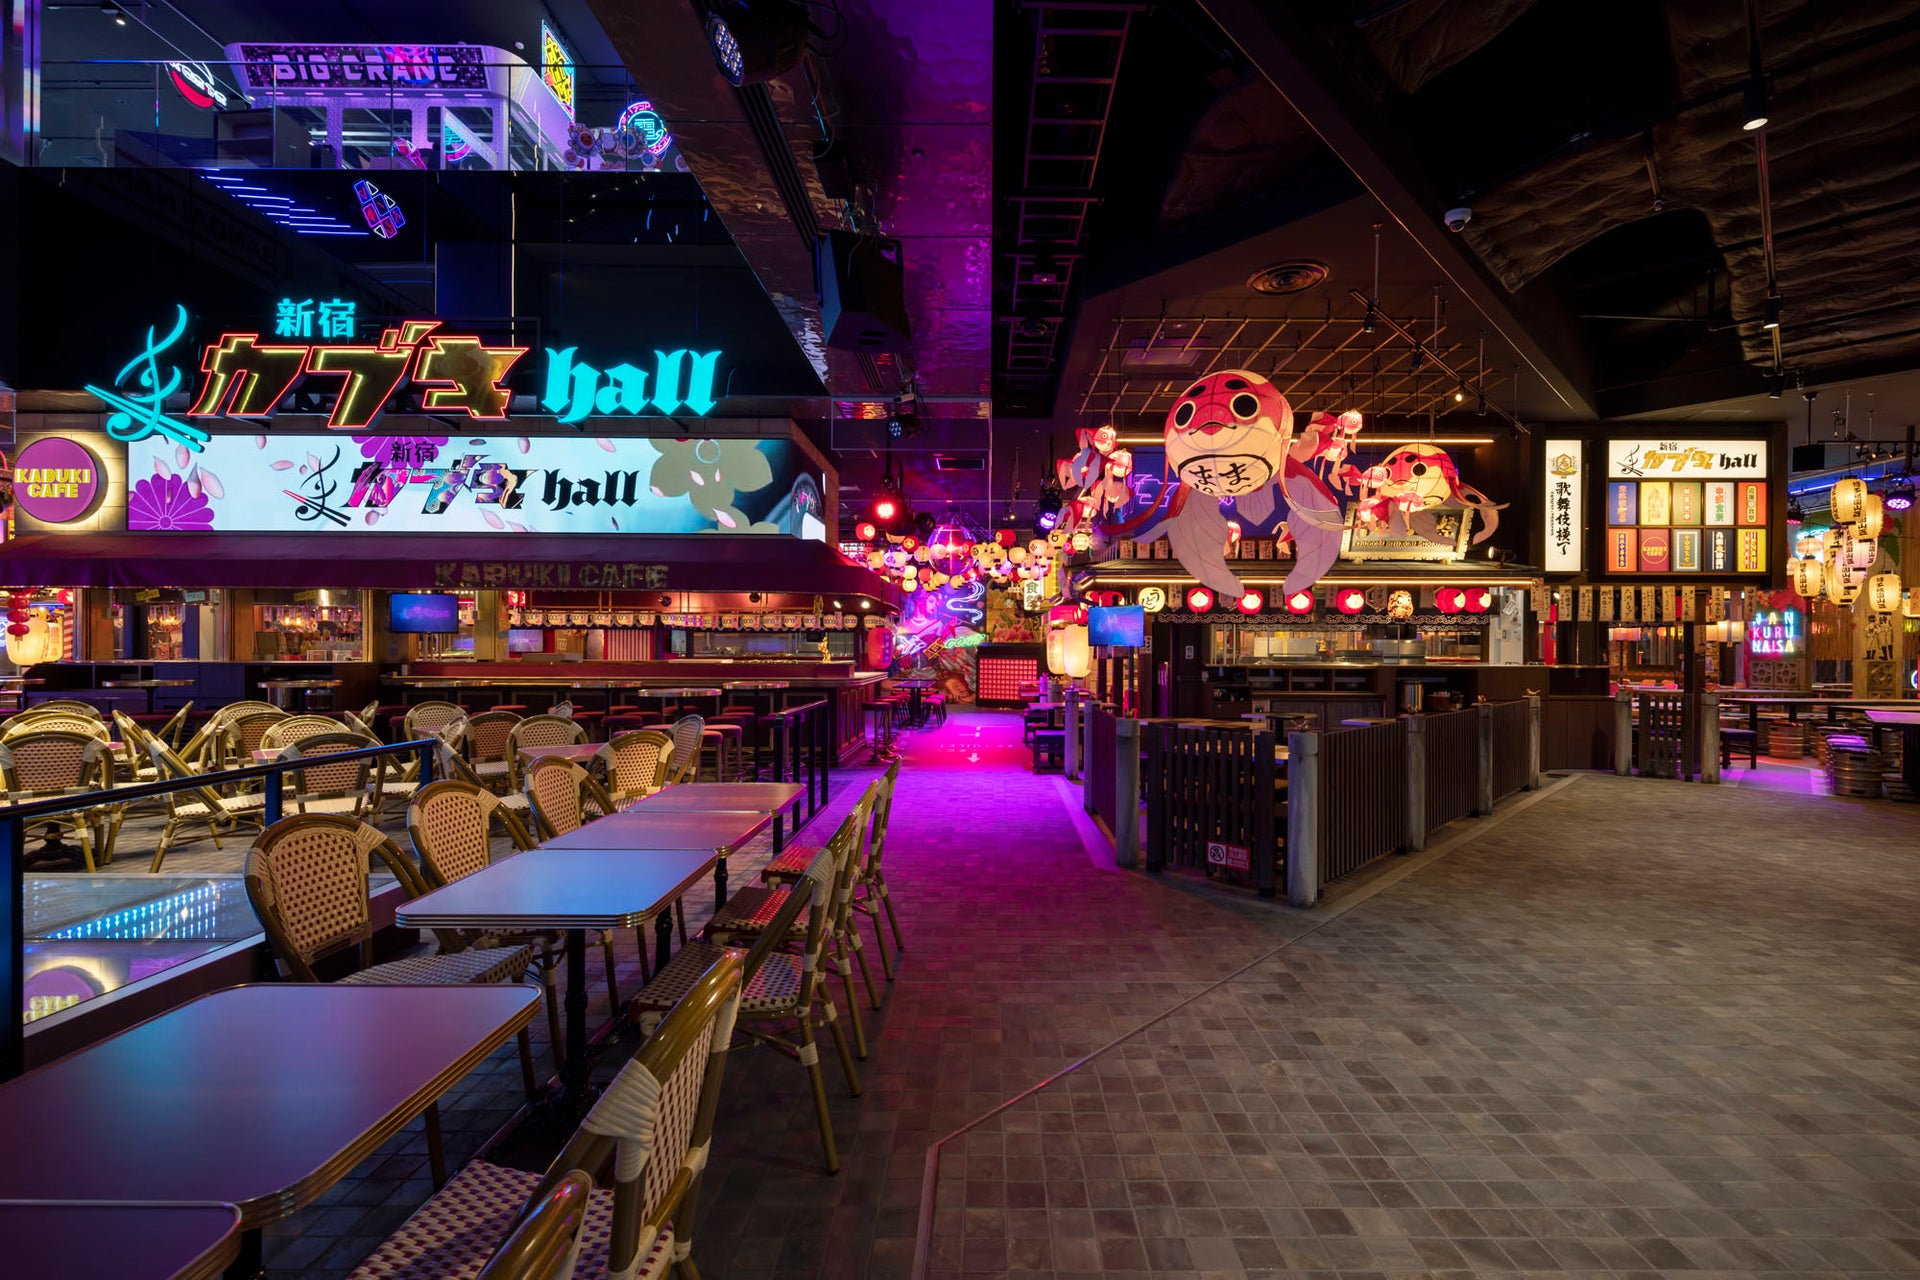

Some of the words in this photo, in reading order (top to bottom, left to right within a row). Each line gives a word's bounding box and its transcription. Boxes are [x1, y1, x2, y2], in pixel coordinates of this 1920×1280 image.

[272, 54, 330, 81] BIG
[341, 54, 458, 82] CRANE
[275, 298, 356, 338] 新宿
[541, 347, 723, 423] hall
[391, 442, 435, 463] 新宿
[1660, 442, 1677, 451] 新宿
[1719, 453, 1757, 470] hall
[15, 468, 91, 483] KABUKI
[27, 483, 79, 498] CAFE
[541, 468, 641, 511] hall
[1555, 481, 1572, 556] 歌舞伎横丁
[435, 563, 571, 588] KABUKI
[578, 563, 669, 589] CAFE
[1752, 626, 1794, 639] KURU
[1752, 639, 1794, 653] NAISA
